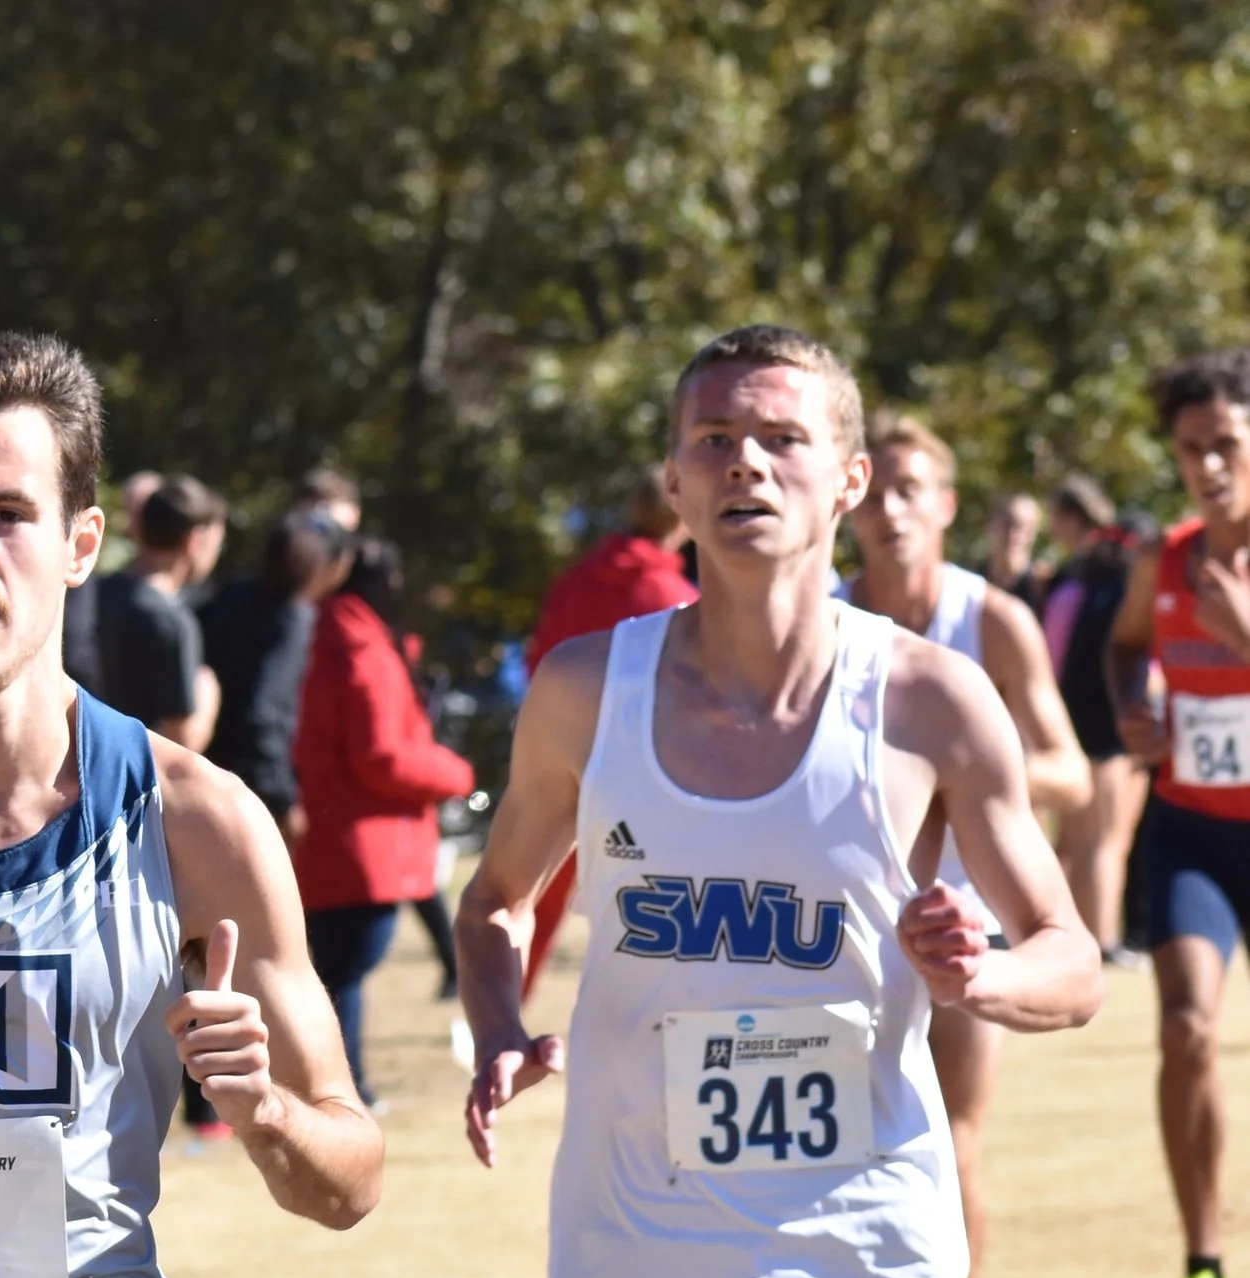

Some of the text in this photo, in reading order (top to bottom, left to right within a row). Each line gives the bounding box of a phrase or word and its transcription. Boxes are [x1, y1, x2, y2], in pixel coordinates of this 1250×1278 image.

[615, 874, 845, 970] SWU
[736, 1035, 830, 1052] CROSS COUNTRY
[698, 1071, 838, 1164] 343
